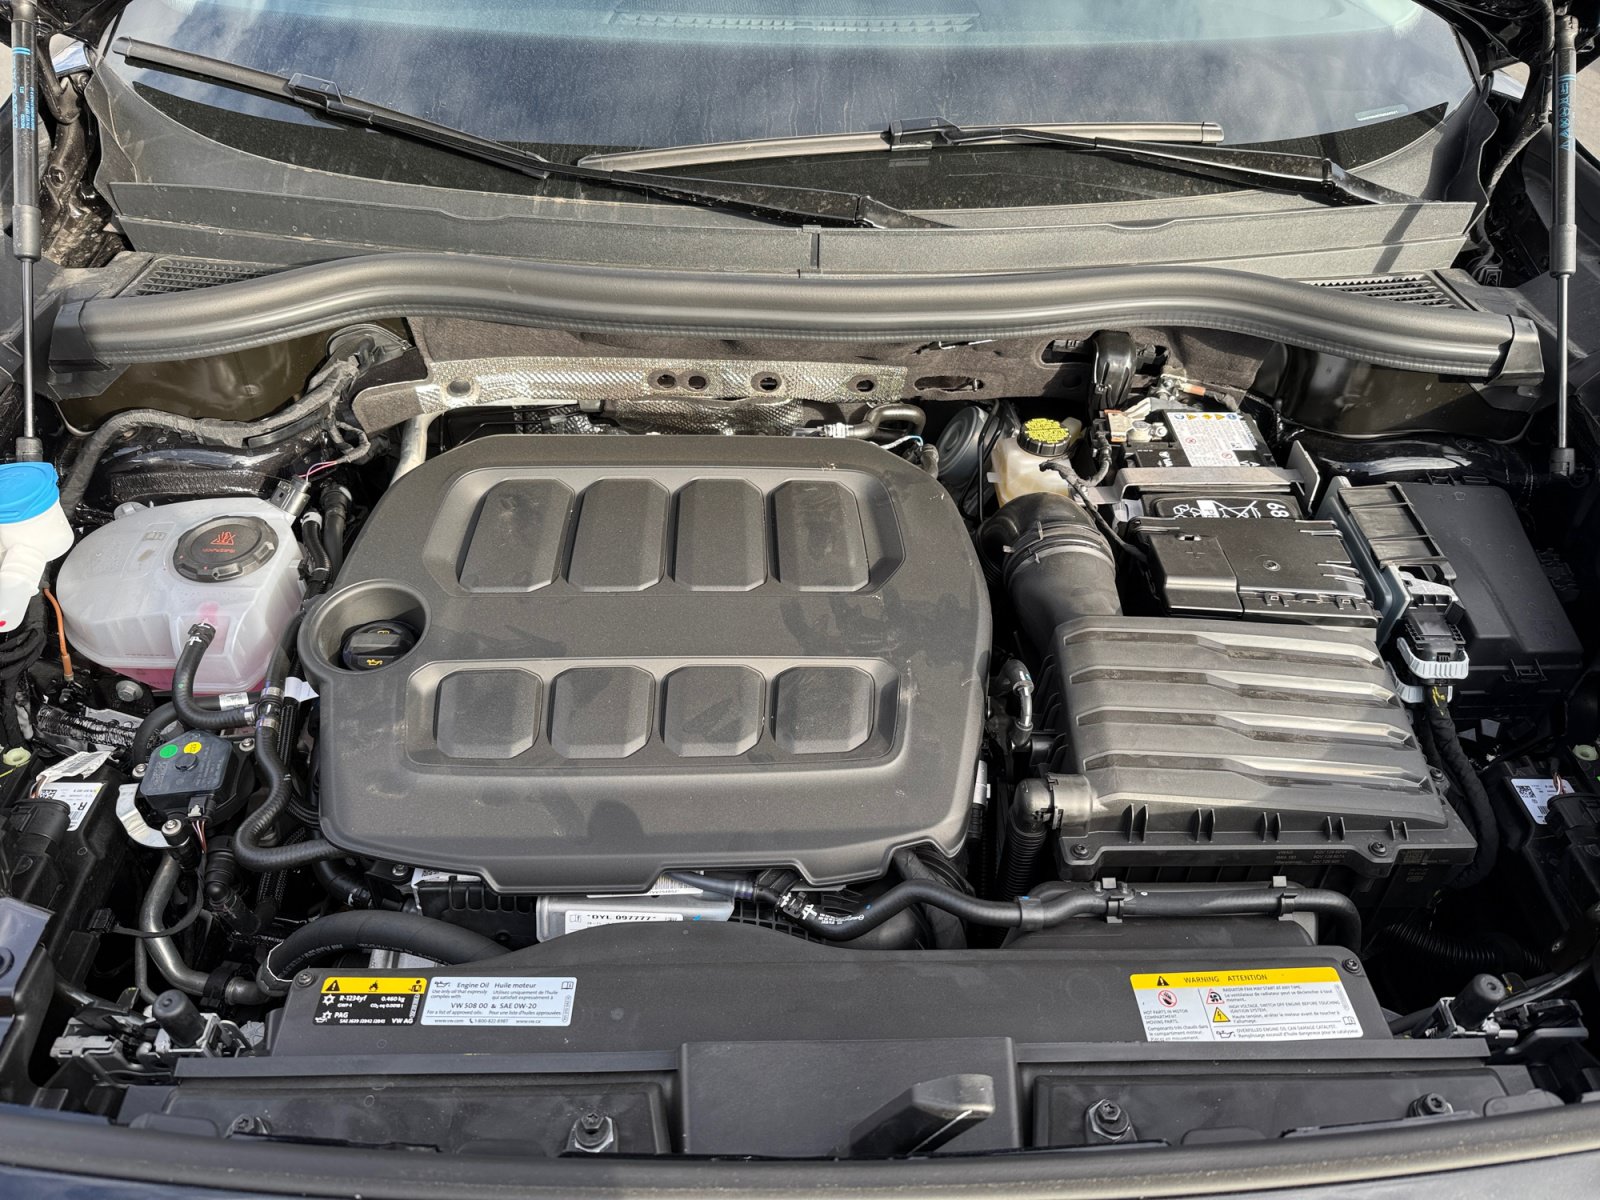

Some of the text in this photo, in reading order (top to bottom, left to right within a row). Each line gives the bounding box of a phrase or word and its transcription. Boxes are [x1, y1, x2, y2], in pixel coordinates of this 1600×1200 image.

[1183, 974, 1268, 984] WARNING ATTENTION
[456, 982, 479, 990] Engine
[339, 995, 368, 1004] R-1234yf
[398, 995, 406, 1003] kg
